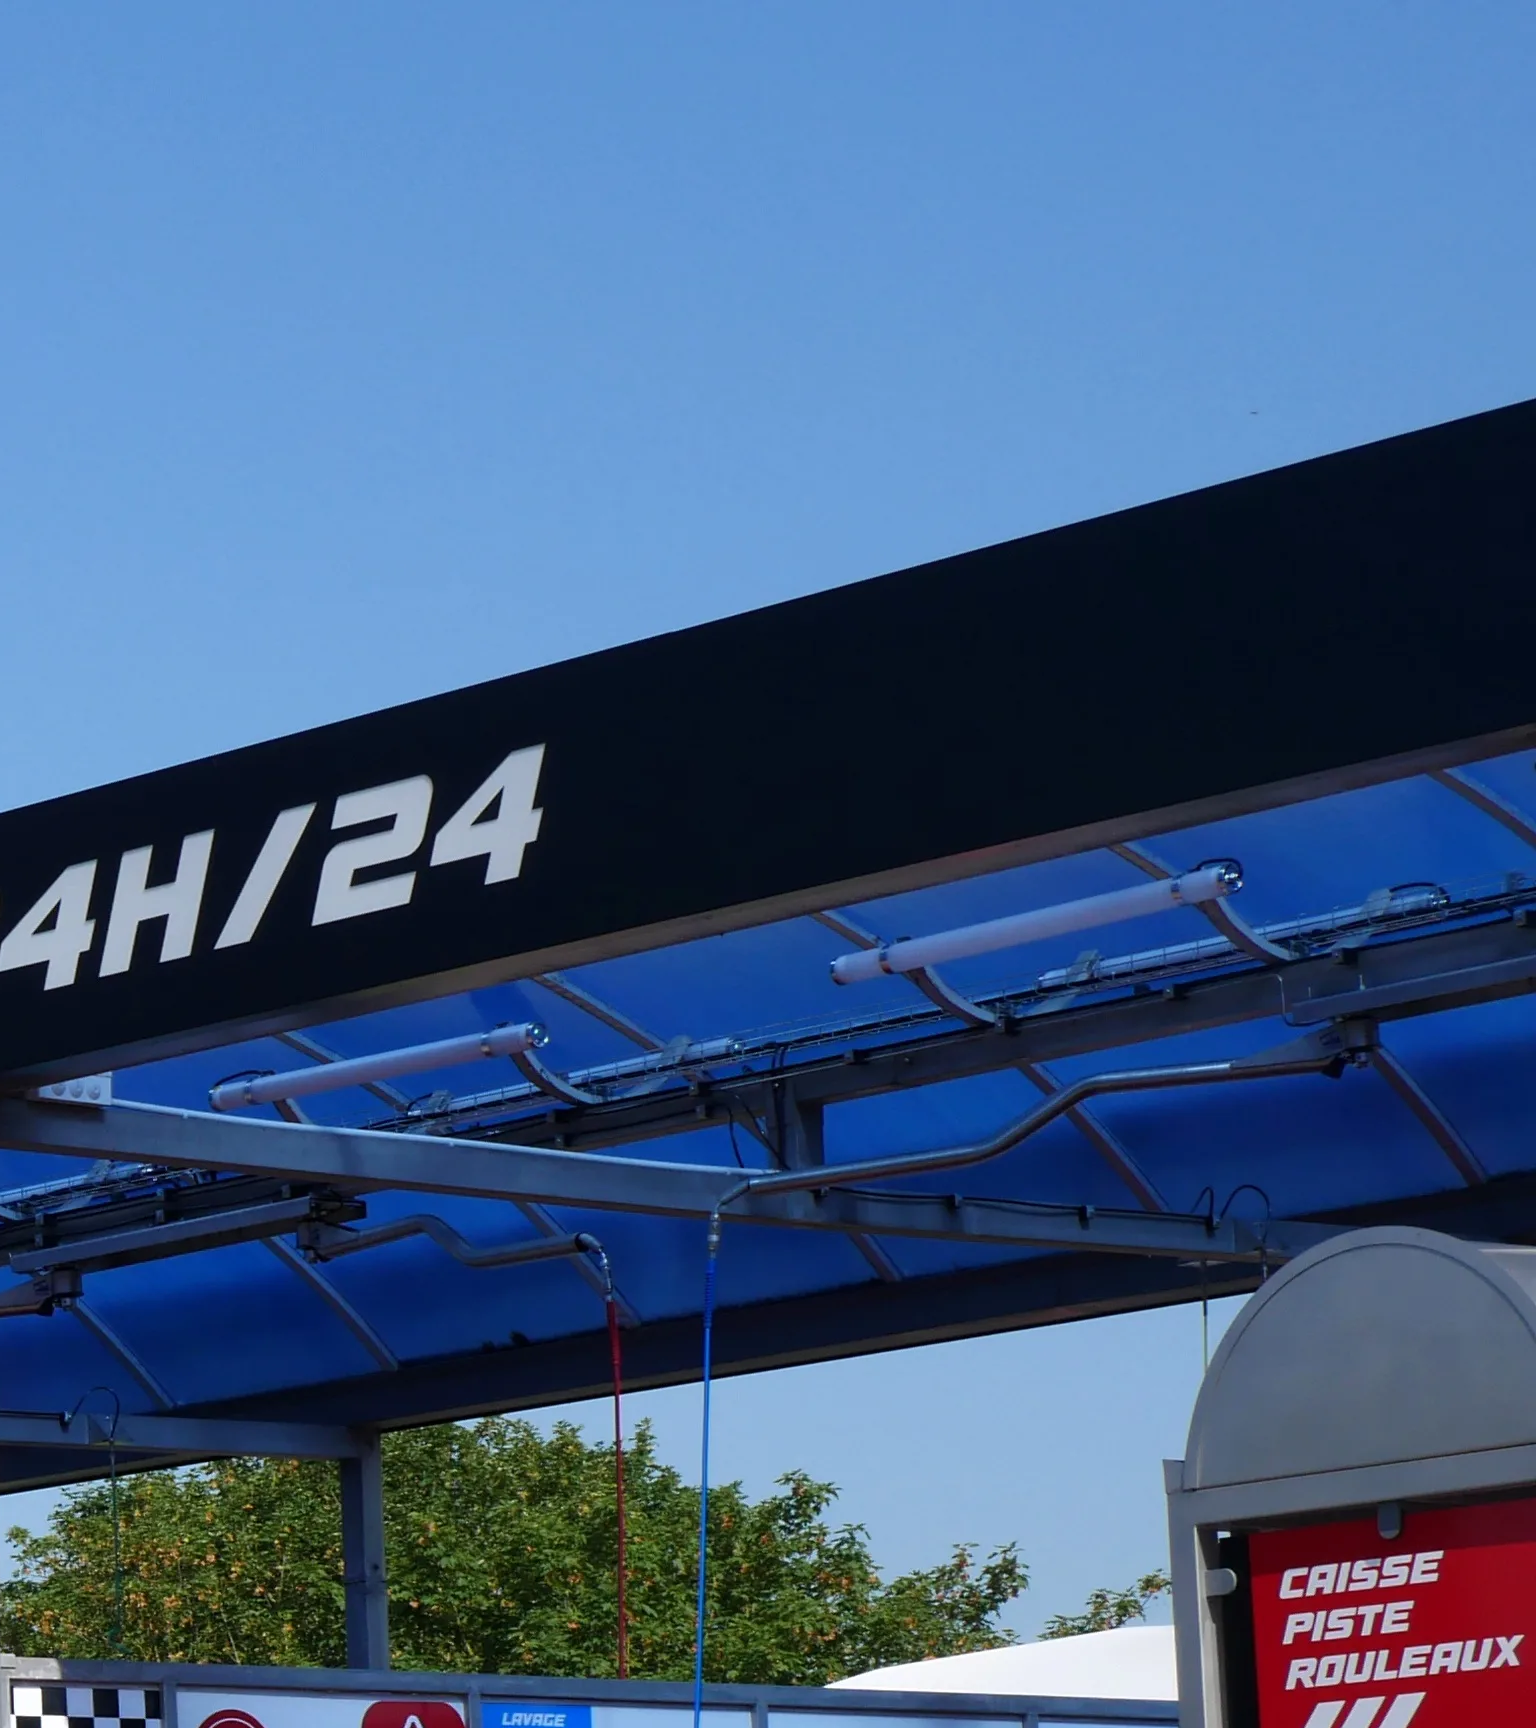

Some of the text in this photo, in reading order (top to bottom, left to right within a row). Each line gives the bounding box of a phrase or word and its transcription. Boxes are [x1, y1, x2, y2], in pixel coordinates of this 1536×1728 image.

[1279, 1550, 1444, 1600] CAISSE
[1282, 1600, 1415, 1645] PISTE
[1285, 1634, 1524, 1691] ROULEAUX
[502, 1713, 566, 1728] LAVAGE
